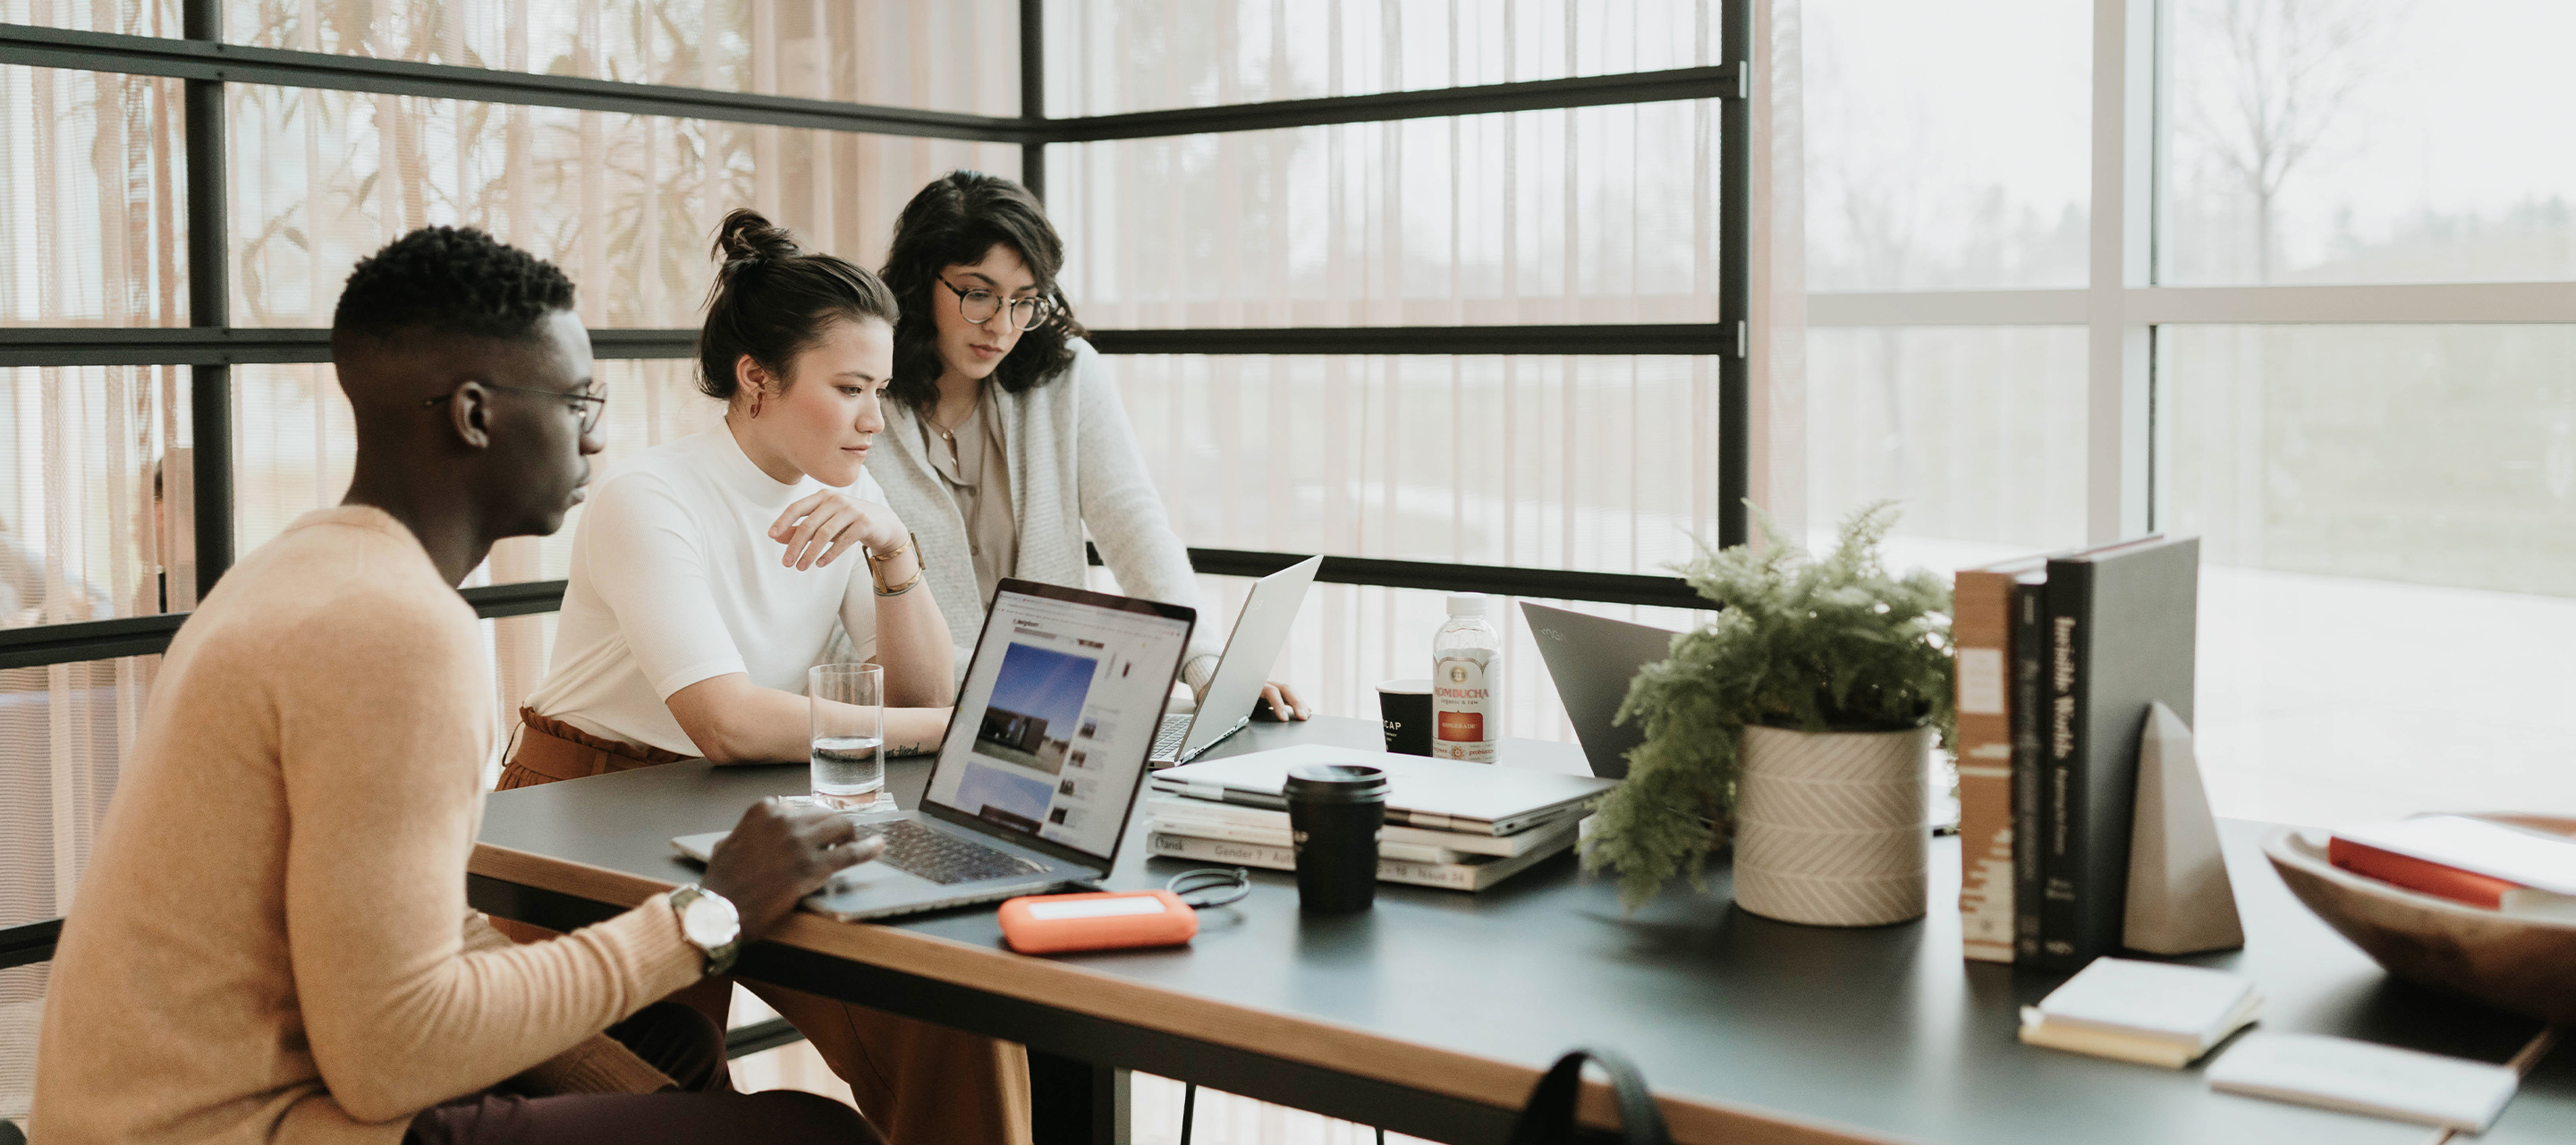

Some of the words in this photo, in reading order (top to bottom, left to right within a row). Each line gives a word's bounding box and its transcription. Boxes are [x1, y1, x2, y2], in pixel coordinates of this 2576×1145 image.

[1434, 686, 1489, 699] KOMBUCHA
[1156, 836, 1184, 851] Dansk
[1215, 844, 1253, 859] Gender
